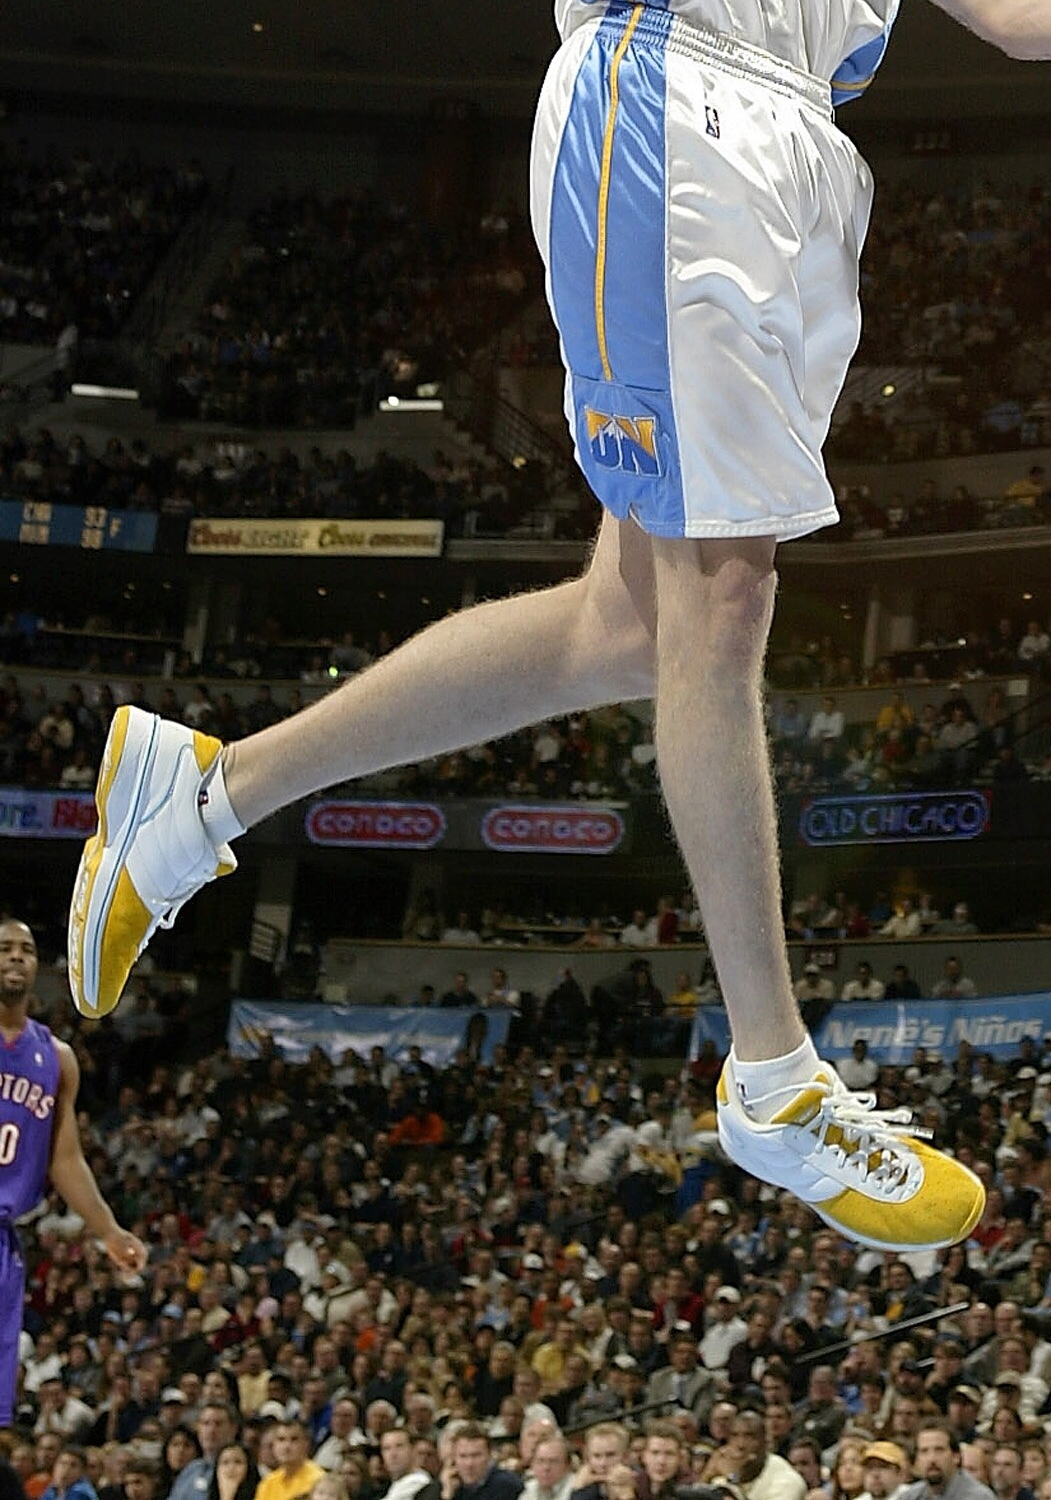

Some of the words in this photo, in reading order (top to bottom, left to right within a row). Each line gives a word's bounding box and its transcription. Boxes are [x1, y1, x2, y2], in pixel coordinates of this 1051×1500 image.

[319, 813, 433, 836] conoco
[495, 818, 612, 841] conoco
[809, 807, 857, 838] OLD
[861, 802, 982, 836] CHICAGO
[0, 1073, 55, 1120] TORS
